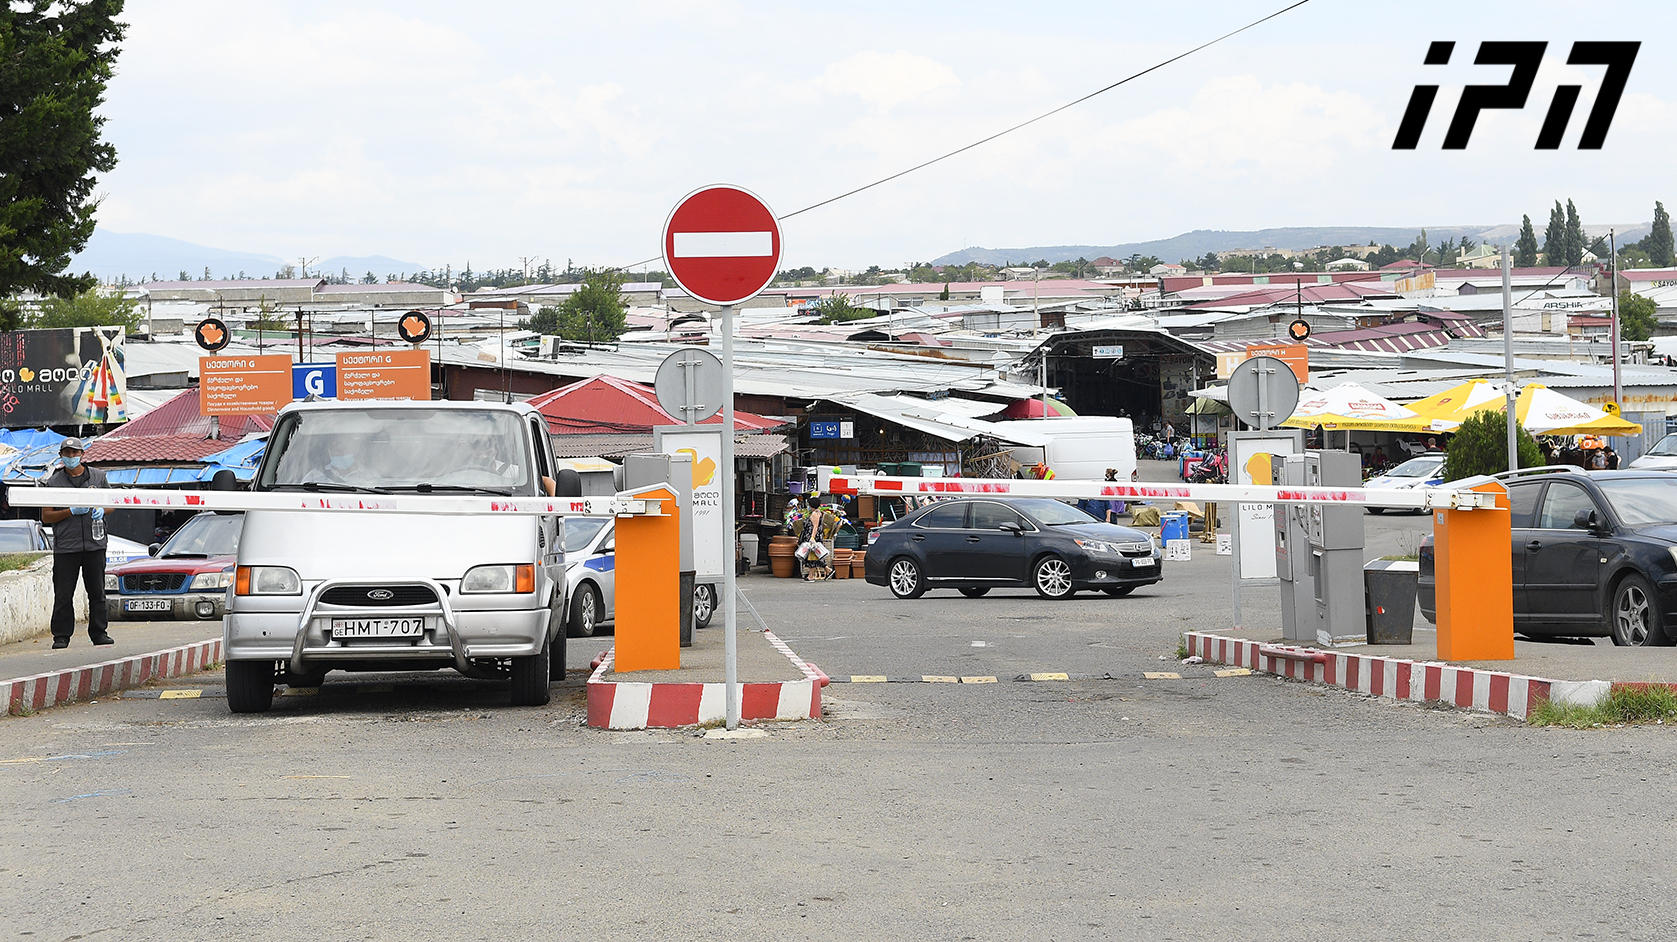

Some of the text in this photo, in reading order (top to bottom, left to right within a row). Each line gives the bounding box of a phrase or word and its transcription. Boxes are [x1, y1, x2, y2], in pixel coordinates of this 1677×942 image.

[385, 355, 392, 363] G
[248, 360, 256, 368] G
[305, 370, 324, 396] G
[26, 384, 53, 393] MALL
